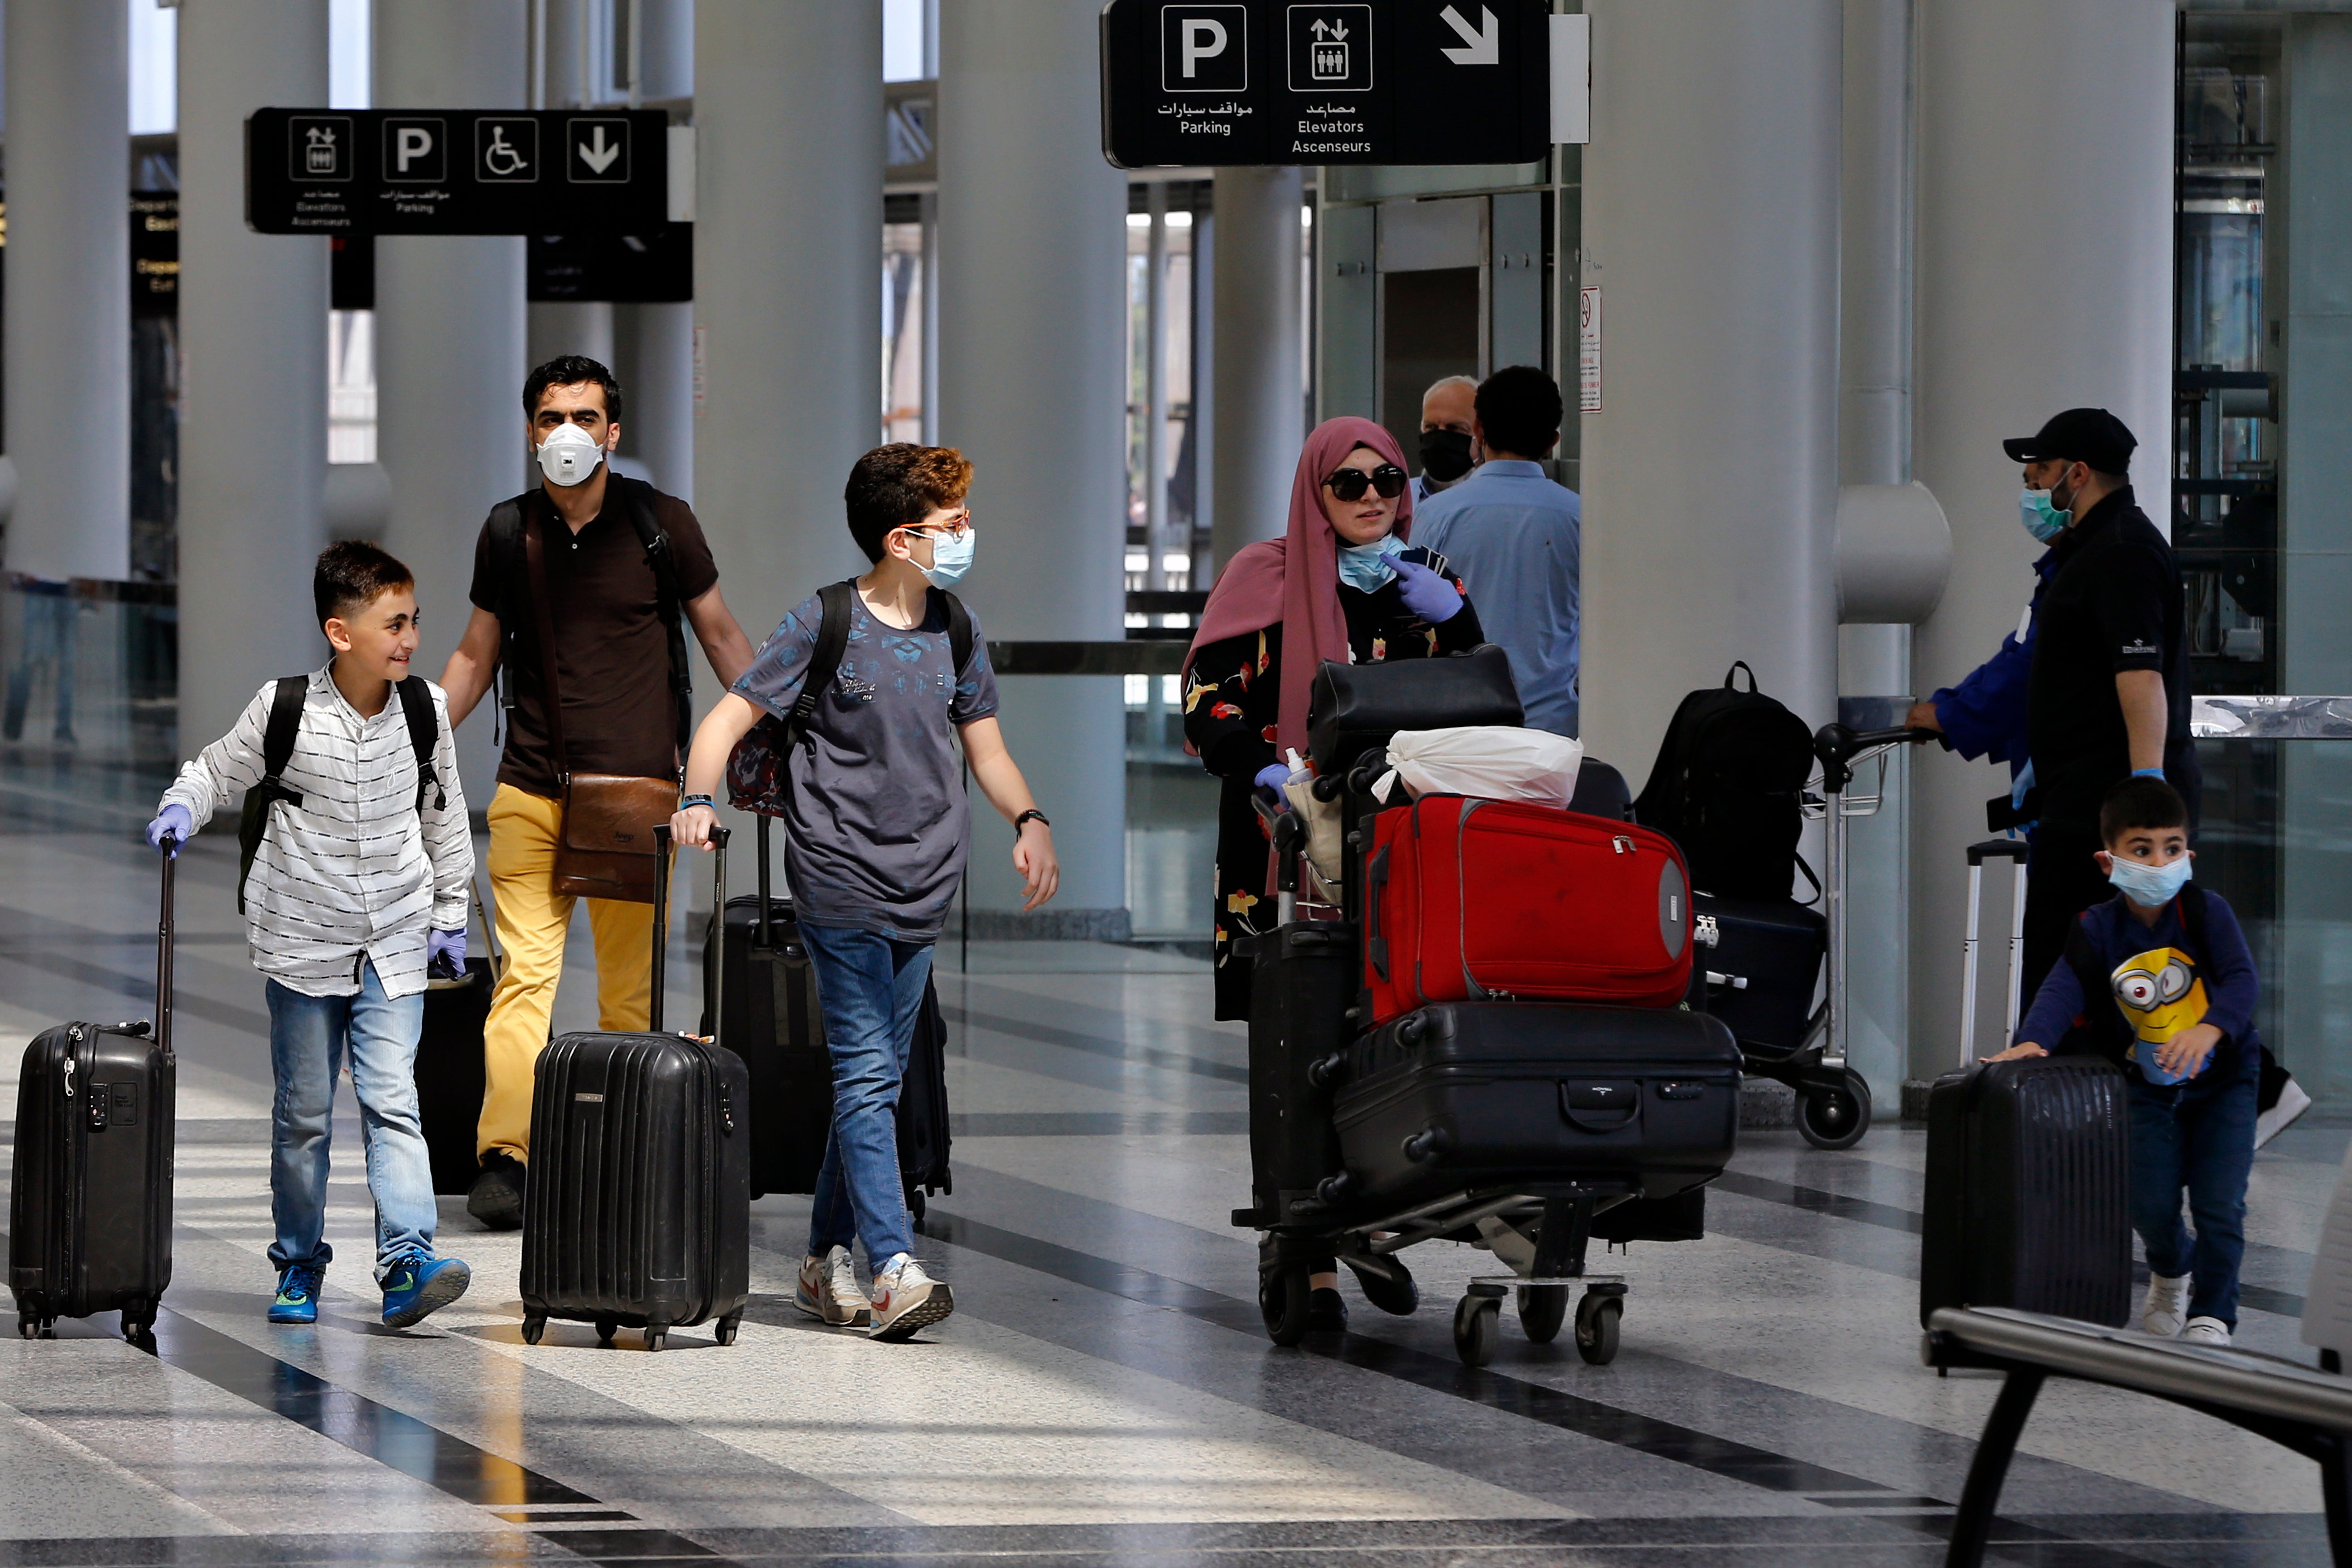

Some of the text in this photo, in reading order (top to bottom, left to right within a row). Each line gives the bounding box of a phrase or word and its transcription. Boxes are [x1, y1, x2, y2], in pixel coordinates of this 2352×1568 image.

[1182, 19, 1227, 78] P
[1158, 102, 1253, 118] مواقف سيارات
[1306, 103, 1356, 118] مصاعد
[1181, 121, 1230, 136] Parking
[1298, 120, 1364, 133] Elevators
[397, 128, 432, 172] P
[1292, 140, 1371, 152] Ascenseurs
[396, 202, 435, 214] Parking
